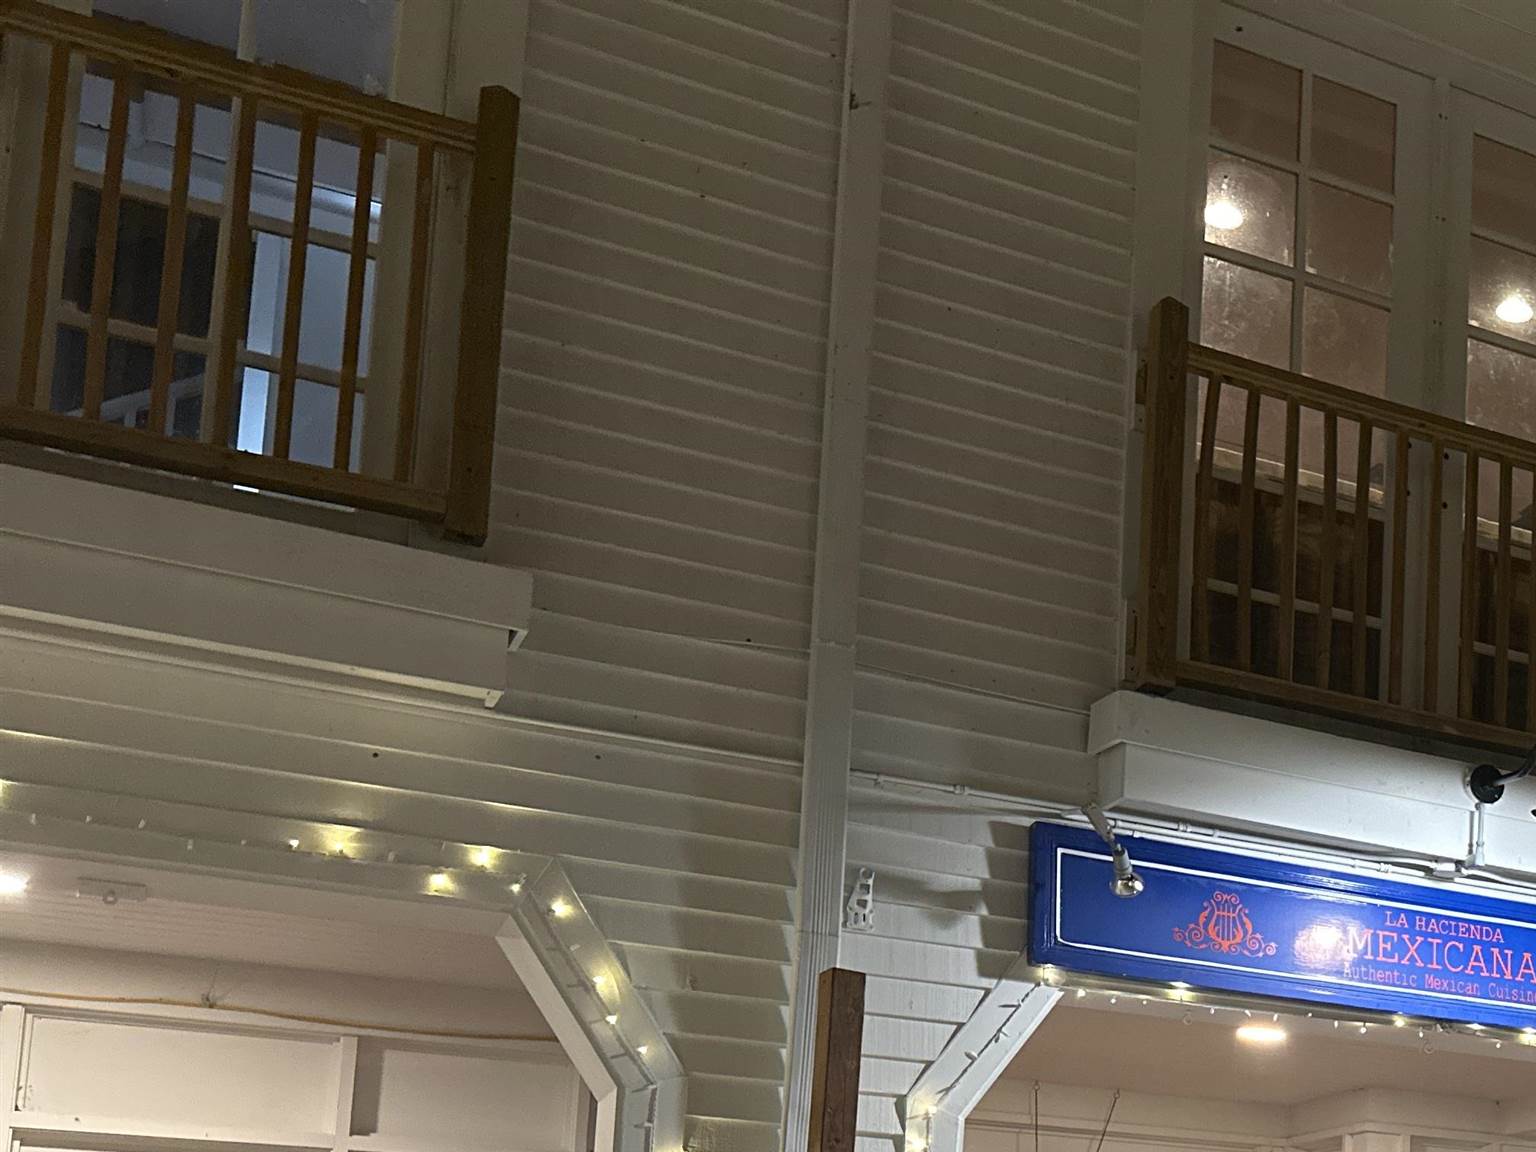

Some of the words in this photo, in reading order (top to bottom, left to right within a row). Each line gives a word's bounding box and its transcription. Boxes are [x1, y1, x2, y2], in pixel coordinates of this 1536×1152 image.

[1384, 911, 1408, 928] LA
[1415, 915, 1505, 943] HACIENDA
[1343, 962, 1417, 986] Authentic
[1424, 974, 1480, 996] Mexican
